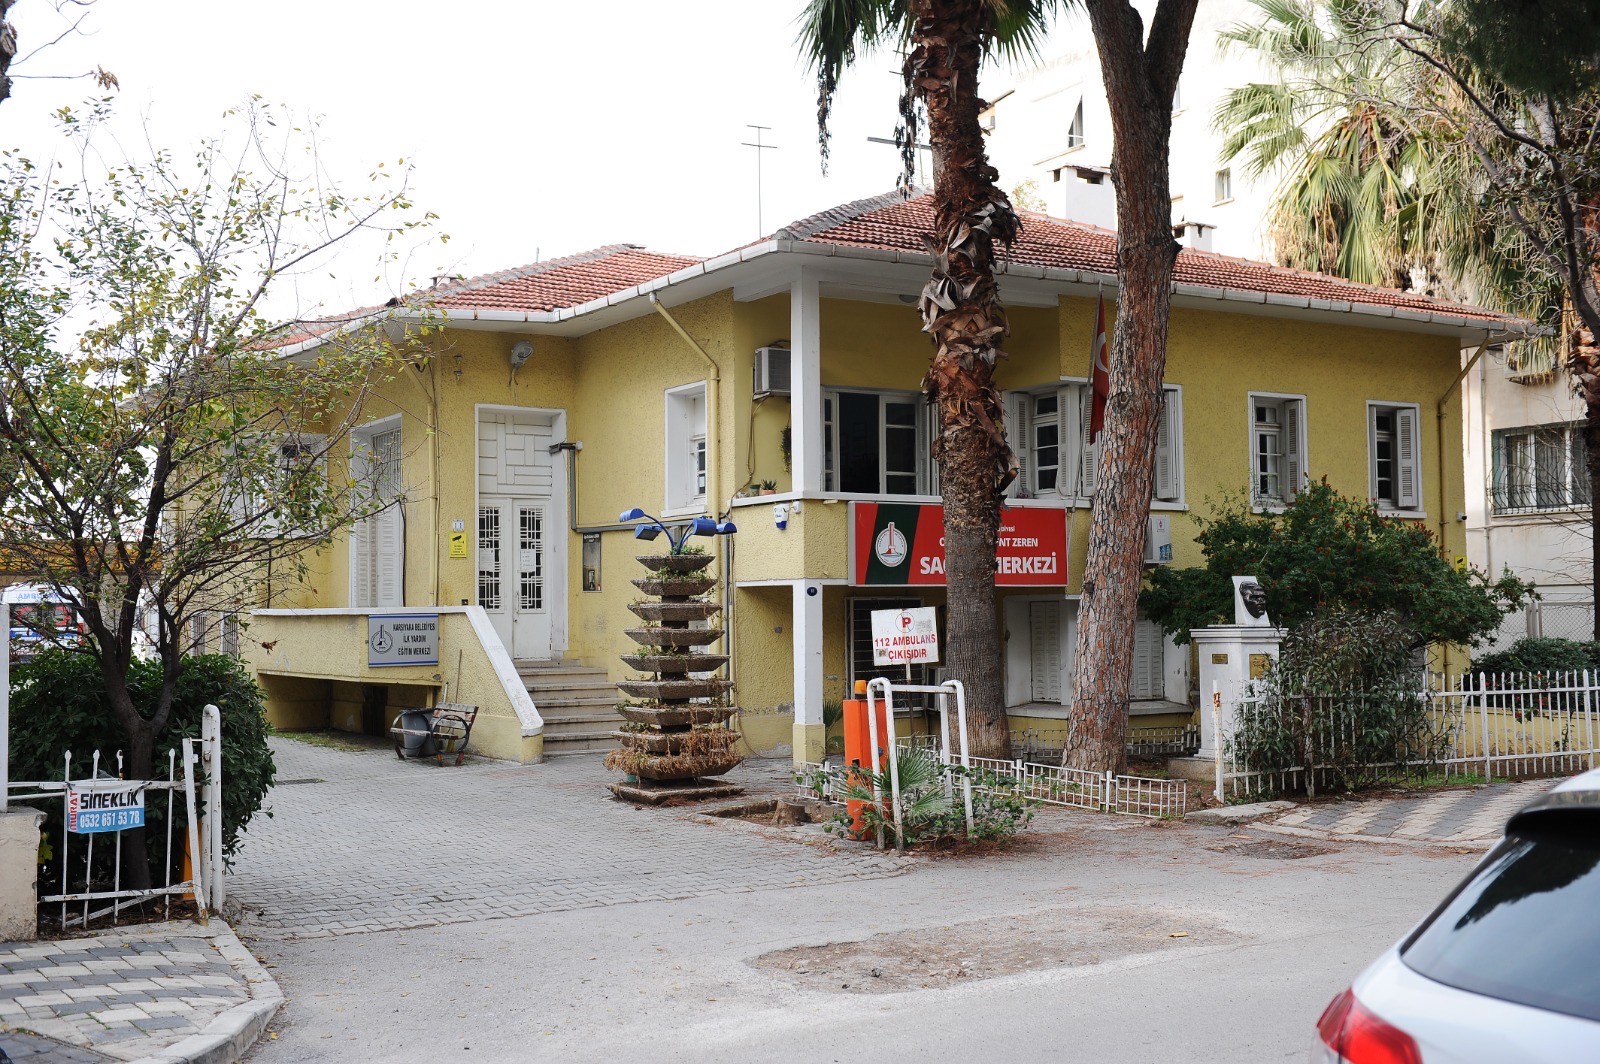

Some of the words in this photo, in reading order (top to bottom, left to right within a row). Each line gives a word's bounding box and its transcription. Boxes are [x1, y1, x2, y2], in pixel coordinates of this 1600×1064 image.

[996, 537, 1011, 547] NT
[1012, 537, 1039, 547] ZEREN
[901, 617, 912, 628] P
[874, 638, 890, 648] 112
[892, 633, 936, 646] AMBULANS
[69, 790, 78, 831] MURAT
[80, 814, 100, 828] 0532
[101, 812, 116, 827] 651
[118, 811, 128, 825] 53
[129, 810, 140, 825] 78
